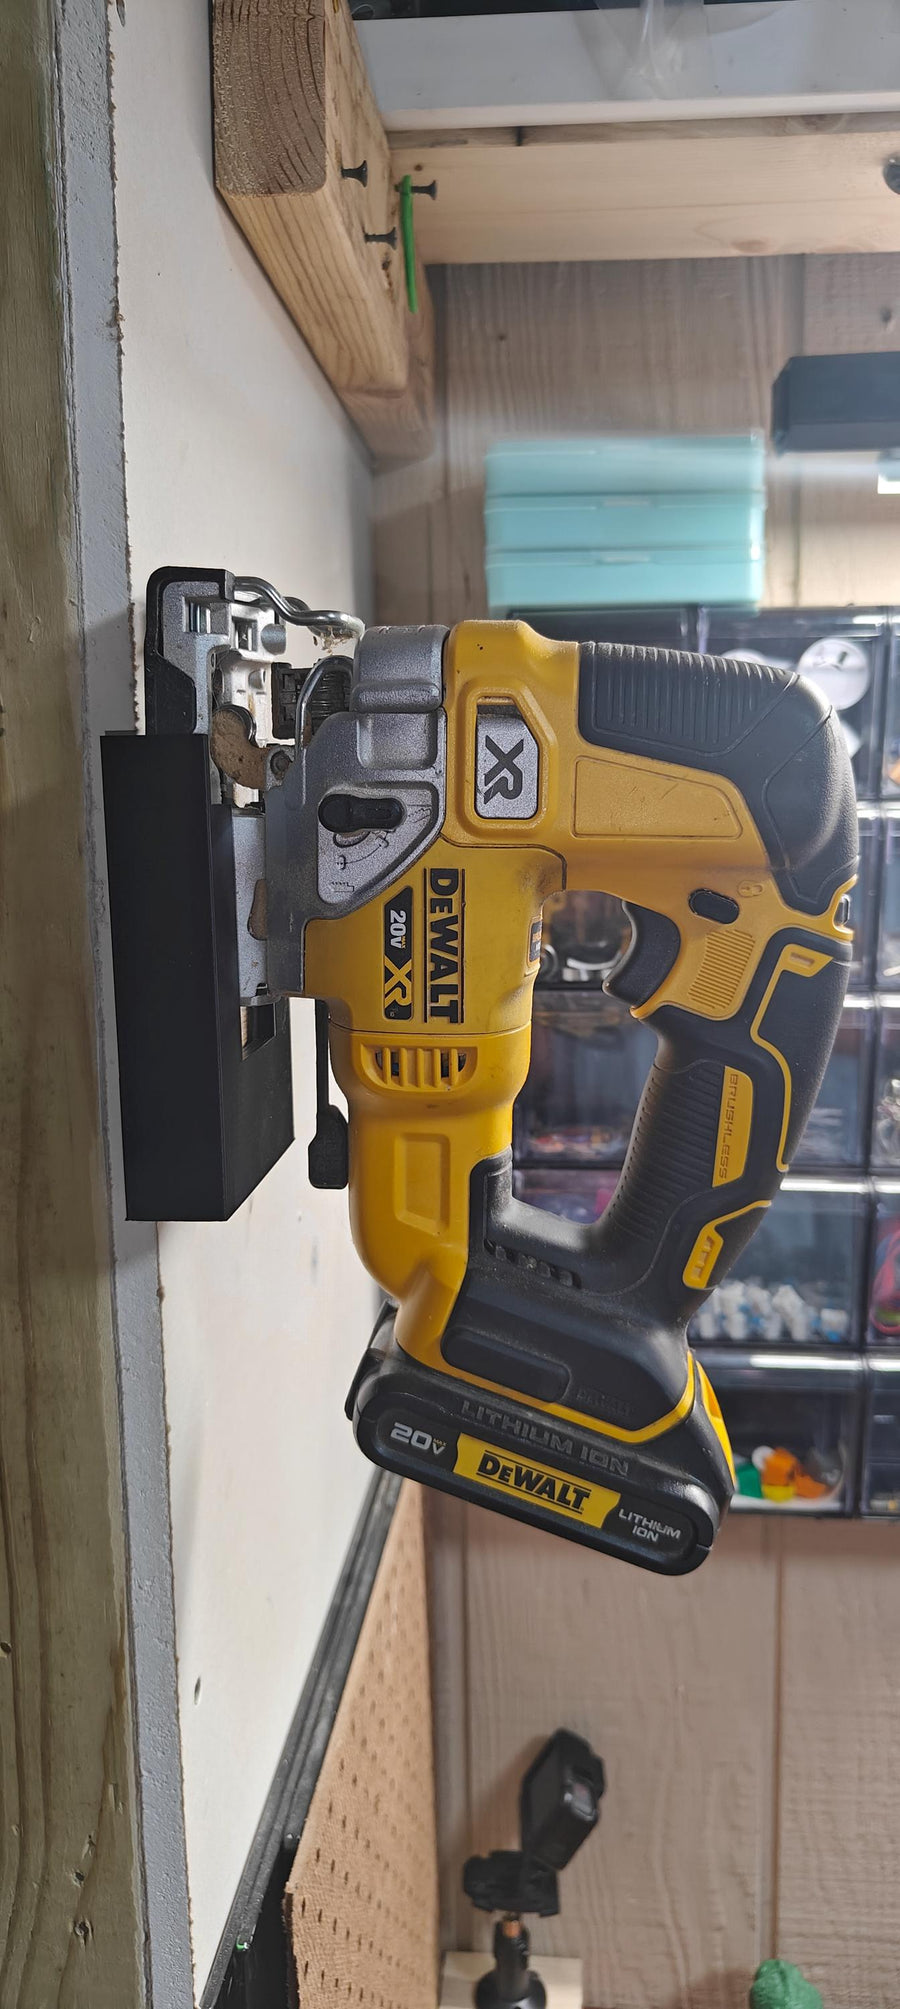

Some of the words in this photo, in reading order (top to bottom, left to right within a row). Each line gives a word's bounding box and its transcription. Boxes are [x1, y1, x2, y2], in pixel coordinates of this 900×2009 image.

[484, 734, 524, 805] XR
[390, 909, 407, 949] 20V
[430, 868, 459, 1024] DEWALT
[385, 954, 412, 1009] XR
[718, 1073, 739, 1179] BRUSHLESS
[390, 1421, 446, 1455] 20V
[460, 1400, 573, 1454] LITHIUM
[579, 1443, 629, 1477] ION
[477, 1453, 590, 1510] DEWALT
[618, 1508, 681, 1540] LITHIUM
[632, 1525, 659, 1543] ION
